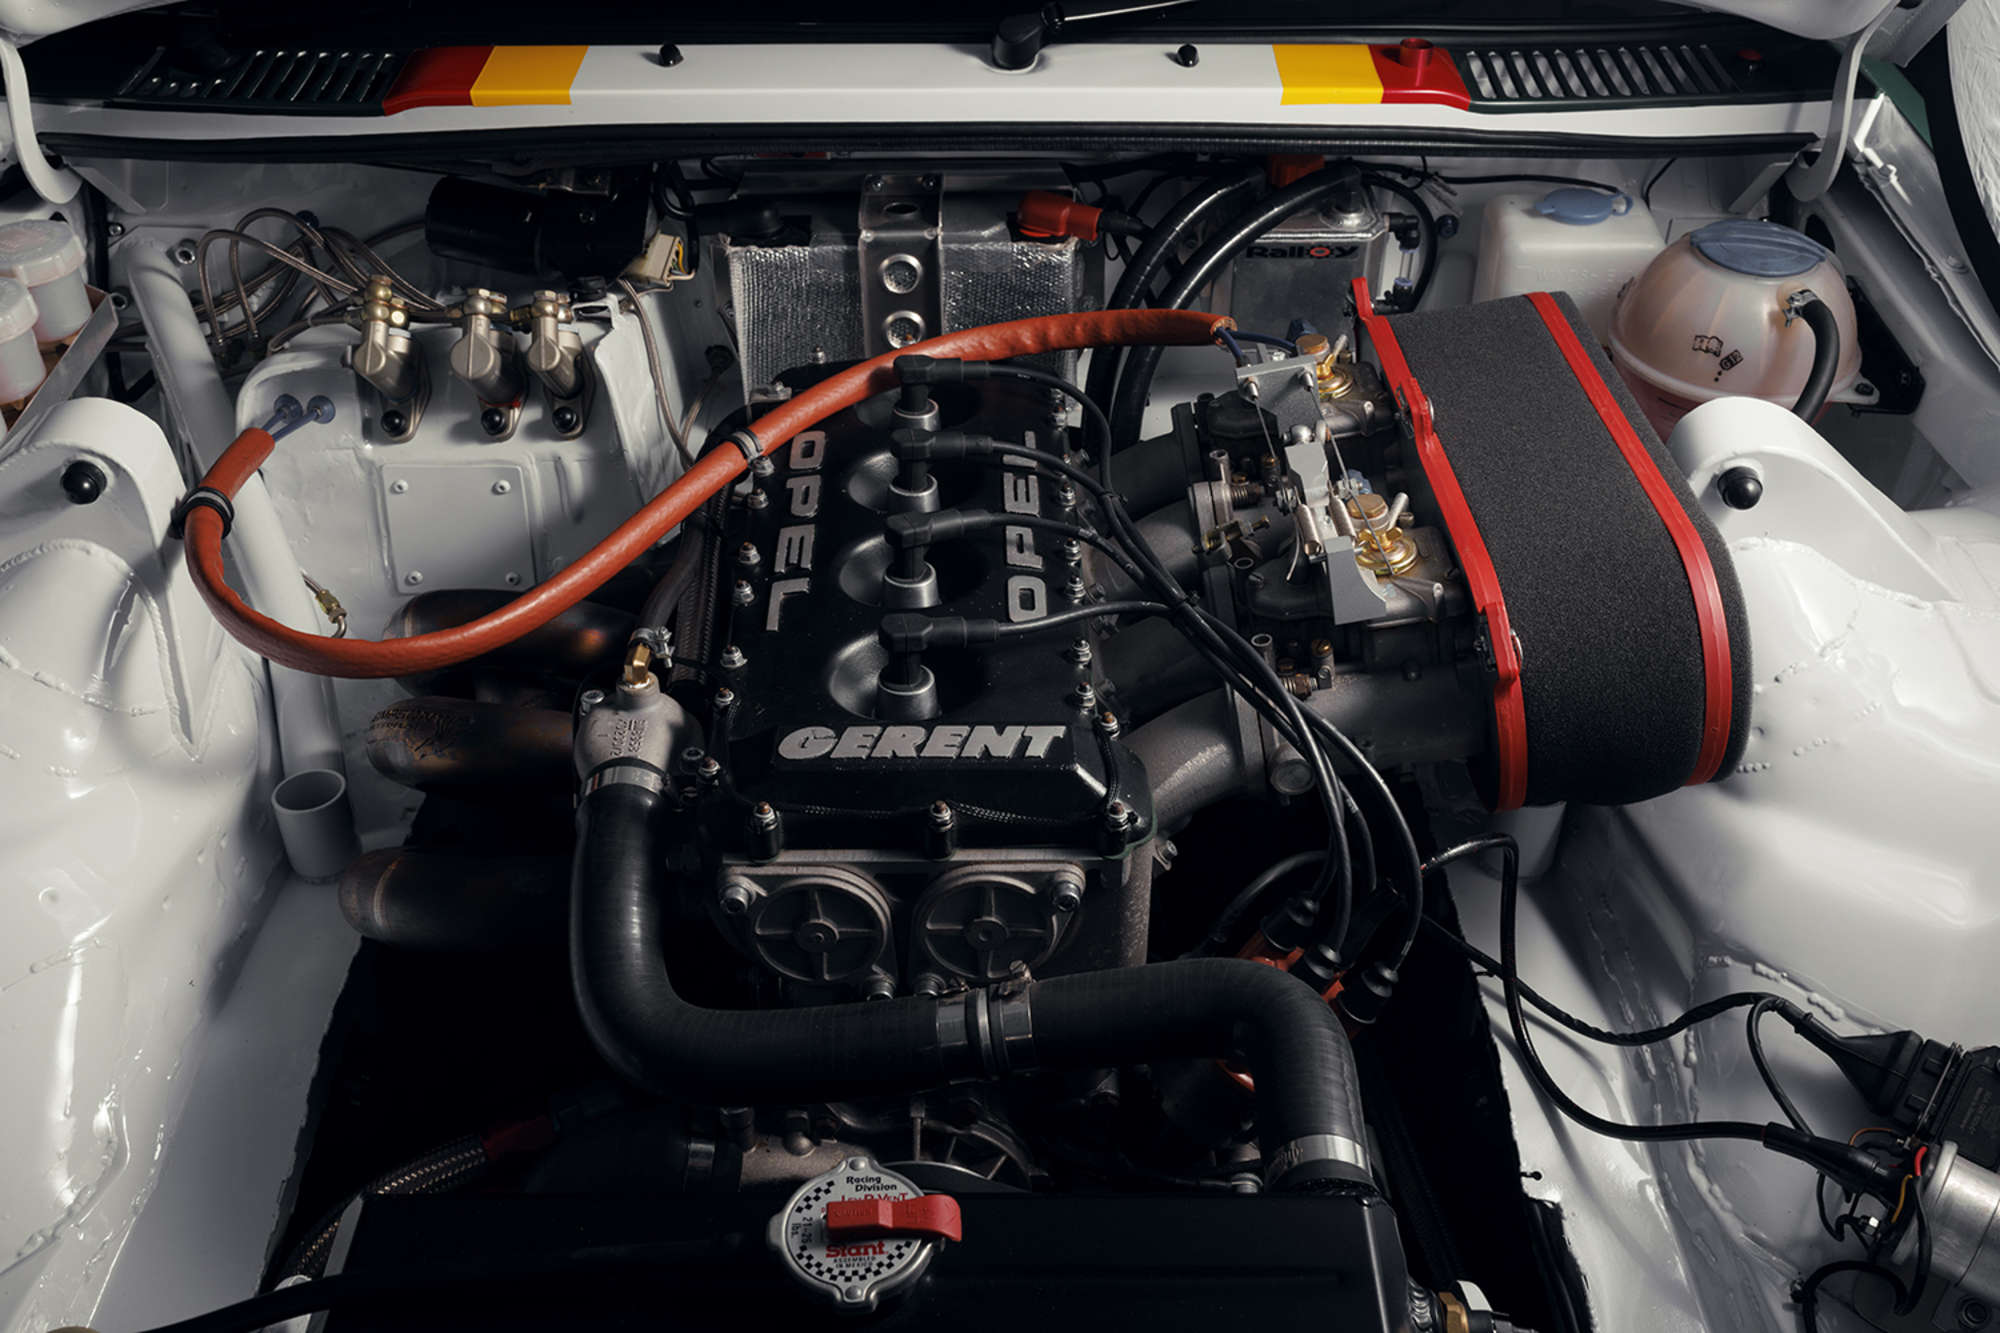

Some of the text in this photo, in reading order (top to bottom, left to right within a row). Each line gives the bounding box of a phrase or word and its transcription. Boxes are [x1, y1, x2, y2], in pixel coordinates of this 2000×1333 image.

[765, 430, 827, 632] OPEL
[1003, 430, 1047, 623] OPEL
[778, 725, 1067, 760] GERENT
[846, 1176, 881, 1185] Racing
[855, 1183, 897, 1192] Division
[825, 1240, 885, 1258] Stant
